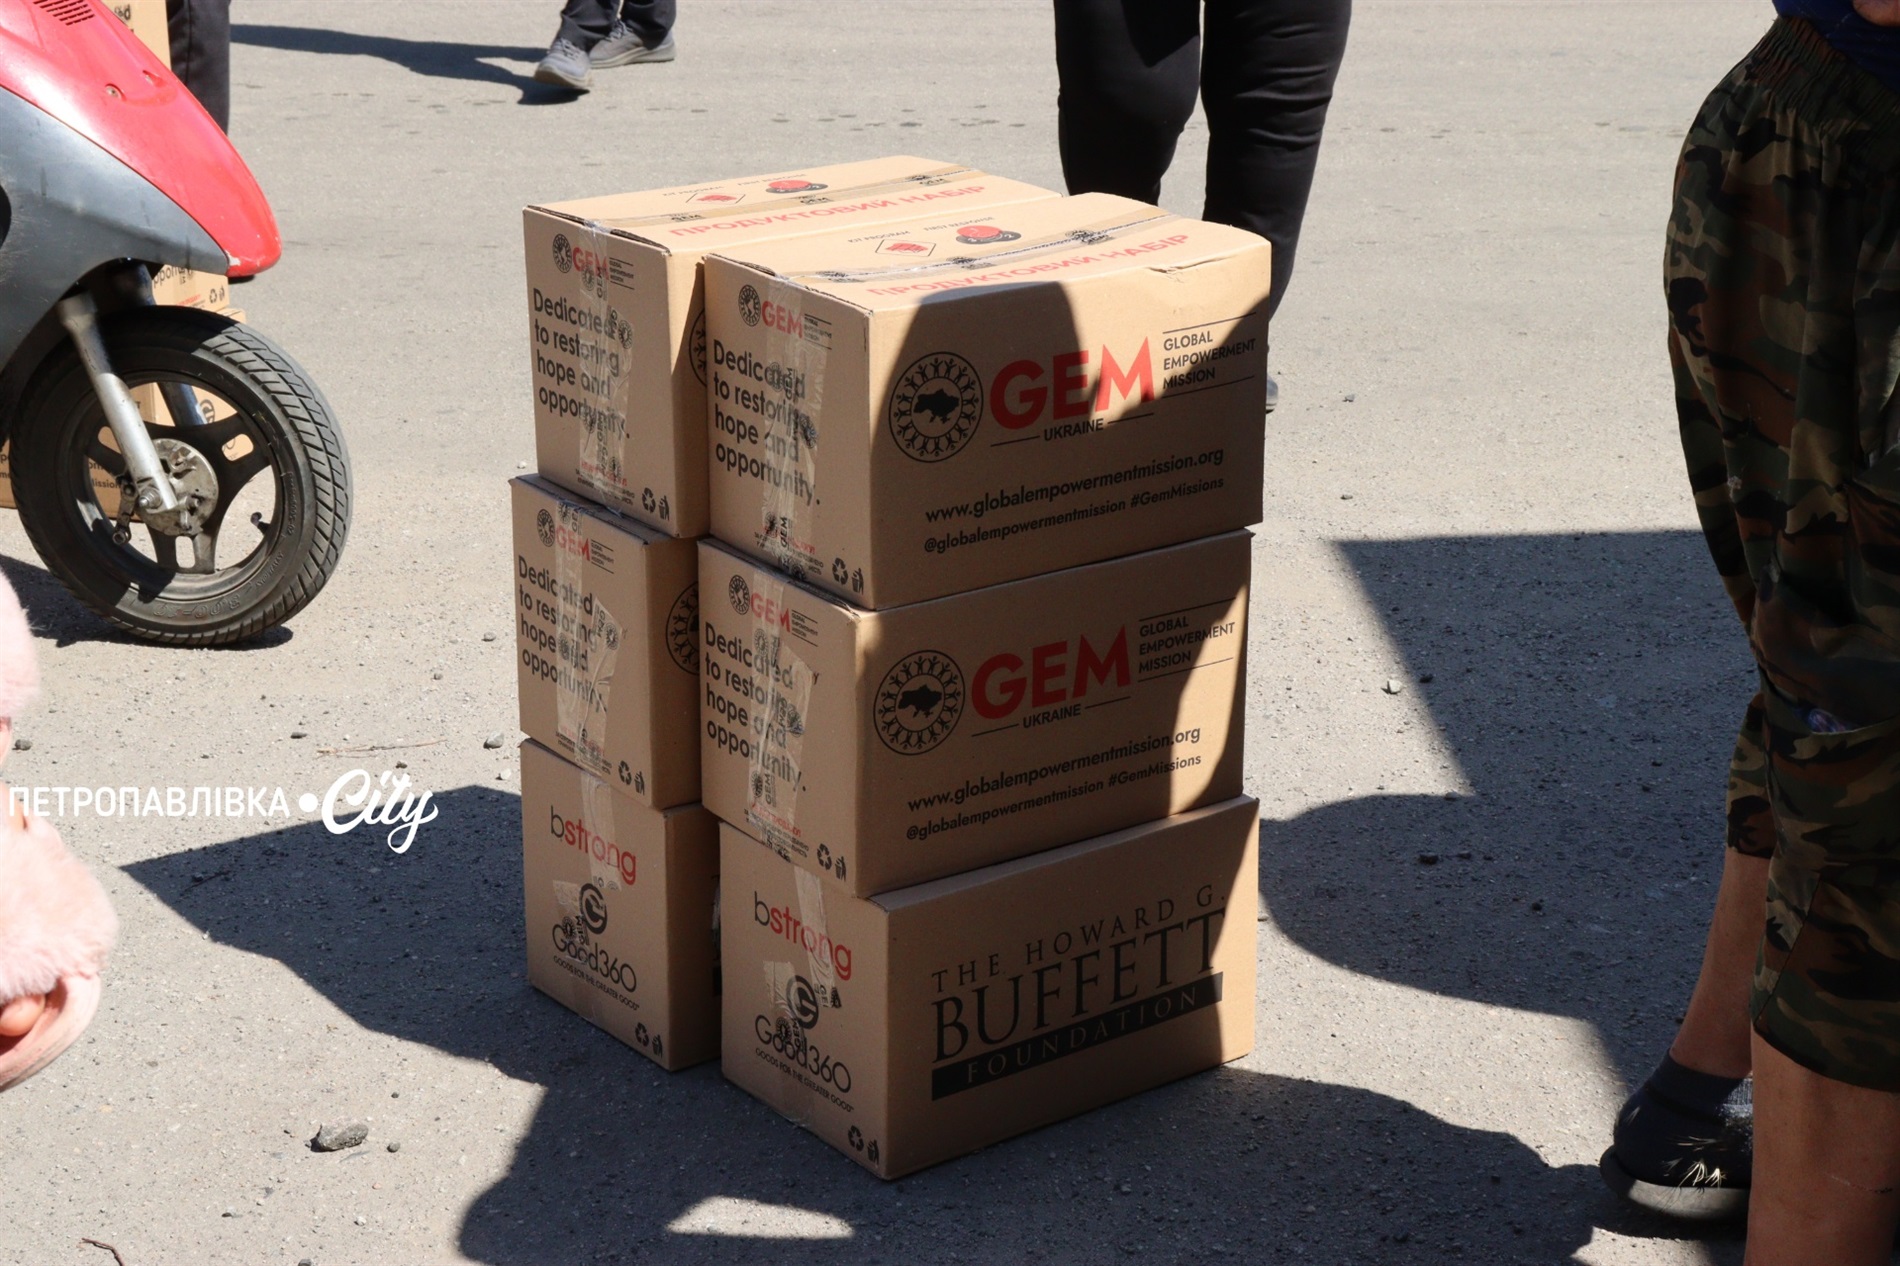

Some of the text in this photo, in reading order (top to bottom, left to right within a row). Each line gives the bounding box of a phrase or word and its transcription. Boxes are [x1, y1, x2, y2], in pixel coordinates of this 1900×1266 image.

[668, 184, 986, 237] ПРОДУКТОВИЙ НАБІР
[866, 233, 1190, 297] ПРОДУКТОВИЙ НАБІР
[534, 318, 550, 346] to
[761, 300, 803, 339] GEM
[1162, 330, 1214, 352] GLOBAL
[1162, 338, 1257, 371] EMPOWERMENT
[537, 349, 576, 386] hope
[714, 370, 731, 401] to
[990, 336, 1157, 431] GEM
[1162, 367, 1217, 390] MISSION
[715, 403, 759, 444] hope
[1043, 417, 1105, 443] UKRAINE
[716, 442, 821, 507] opportunity.
[924, 447, 1225, 524] www.globalempowermentmission.org
[924, 475, 1225, 554] @globalempowermentmission #GemMissions
[555, 525, 591, 562] GEM
[519, 584, 533, 611] to
[751, 592, 791, 633] GEM
[521, 613, 557, 654] hope
[1138, 615, 1190, 638] GLOBAL
[1138, 621, 1236, 657] EMPOWERMENT
[705, 651, 721, 681] to
[971, 625, 1133, 721] GEM
[1137, 650, 1193, 675] MISSION
[706, 682, 749, 728] hope
[1022, 703, 1083, 730] UKRAINE
[907, 725, 1202, 813] www.globalempowermentmission.org
[905, 754, 1203, 841] @globalempowermentmission #GemMissions
[551, 805, 637, 886] bstrong
[755, 891, 853, 981] bstrong
[932, 884, 1226, 994] THE HOWARD G.
[552, 924, 638, 993] Good360
[931, 907, 1227, 1065] BUFFETT
[755, 1014, 852, 1094] Good360
[966, 986, 1197, 1085] FOUNDATION
